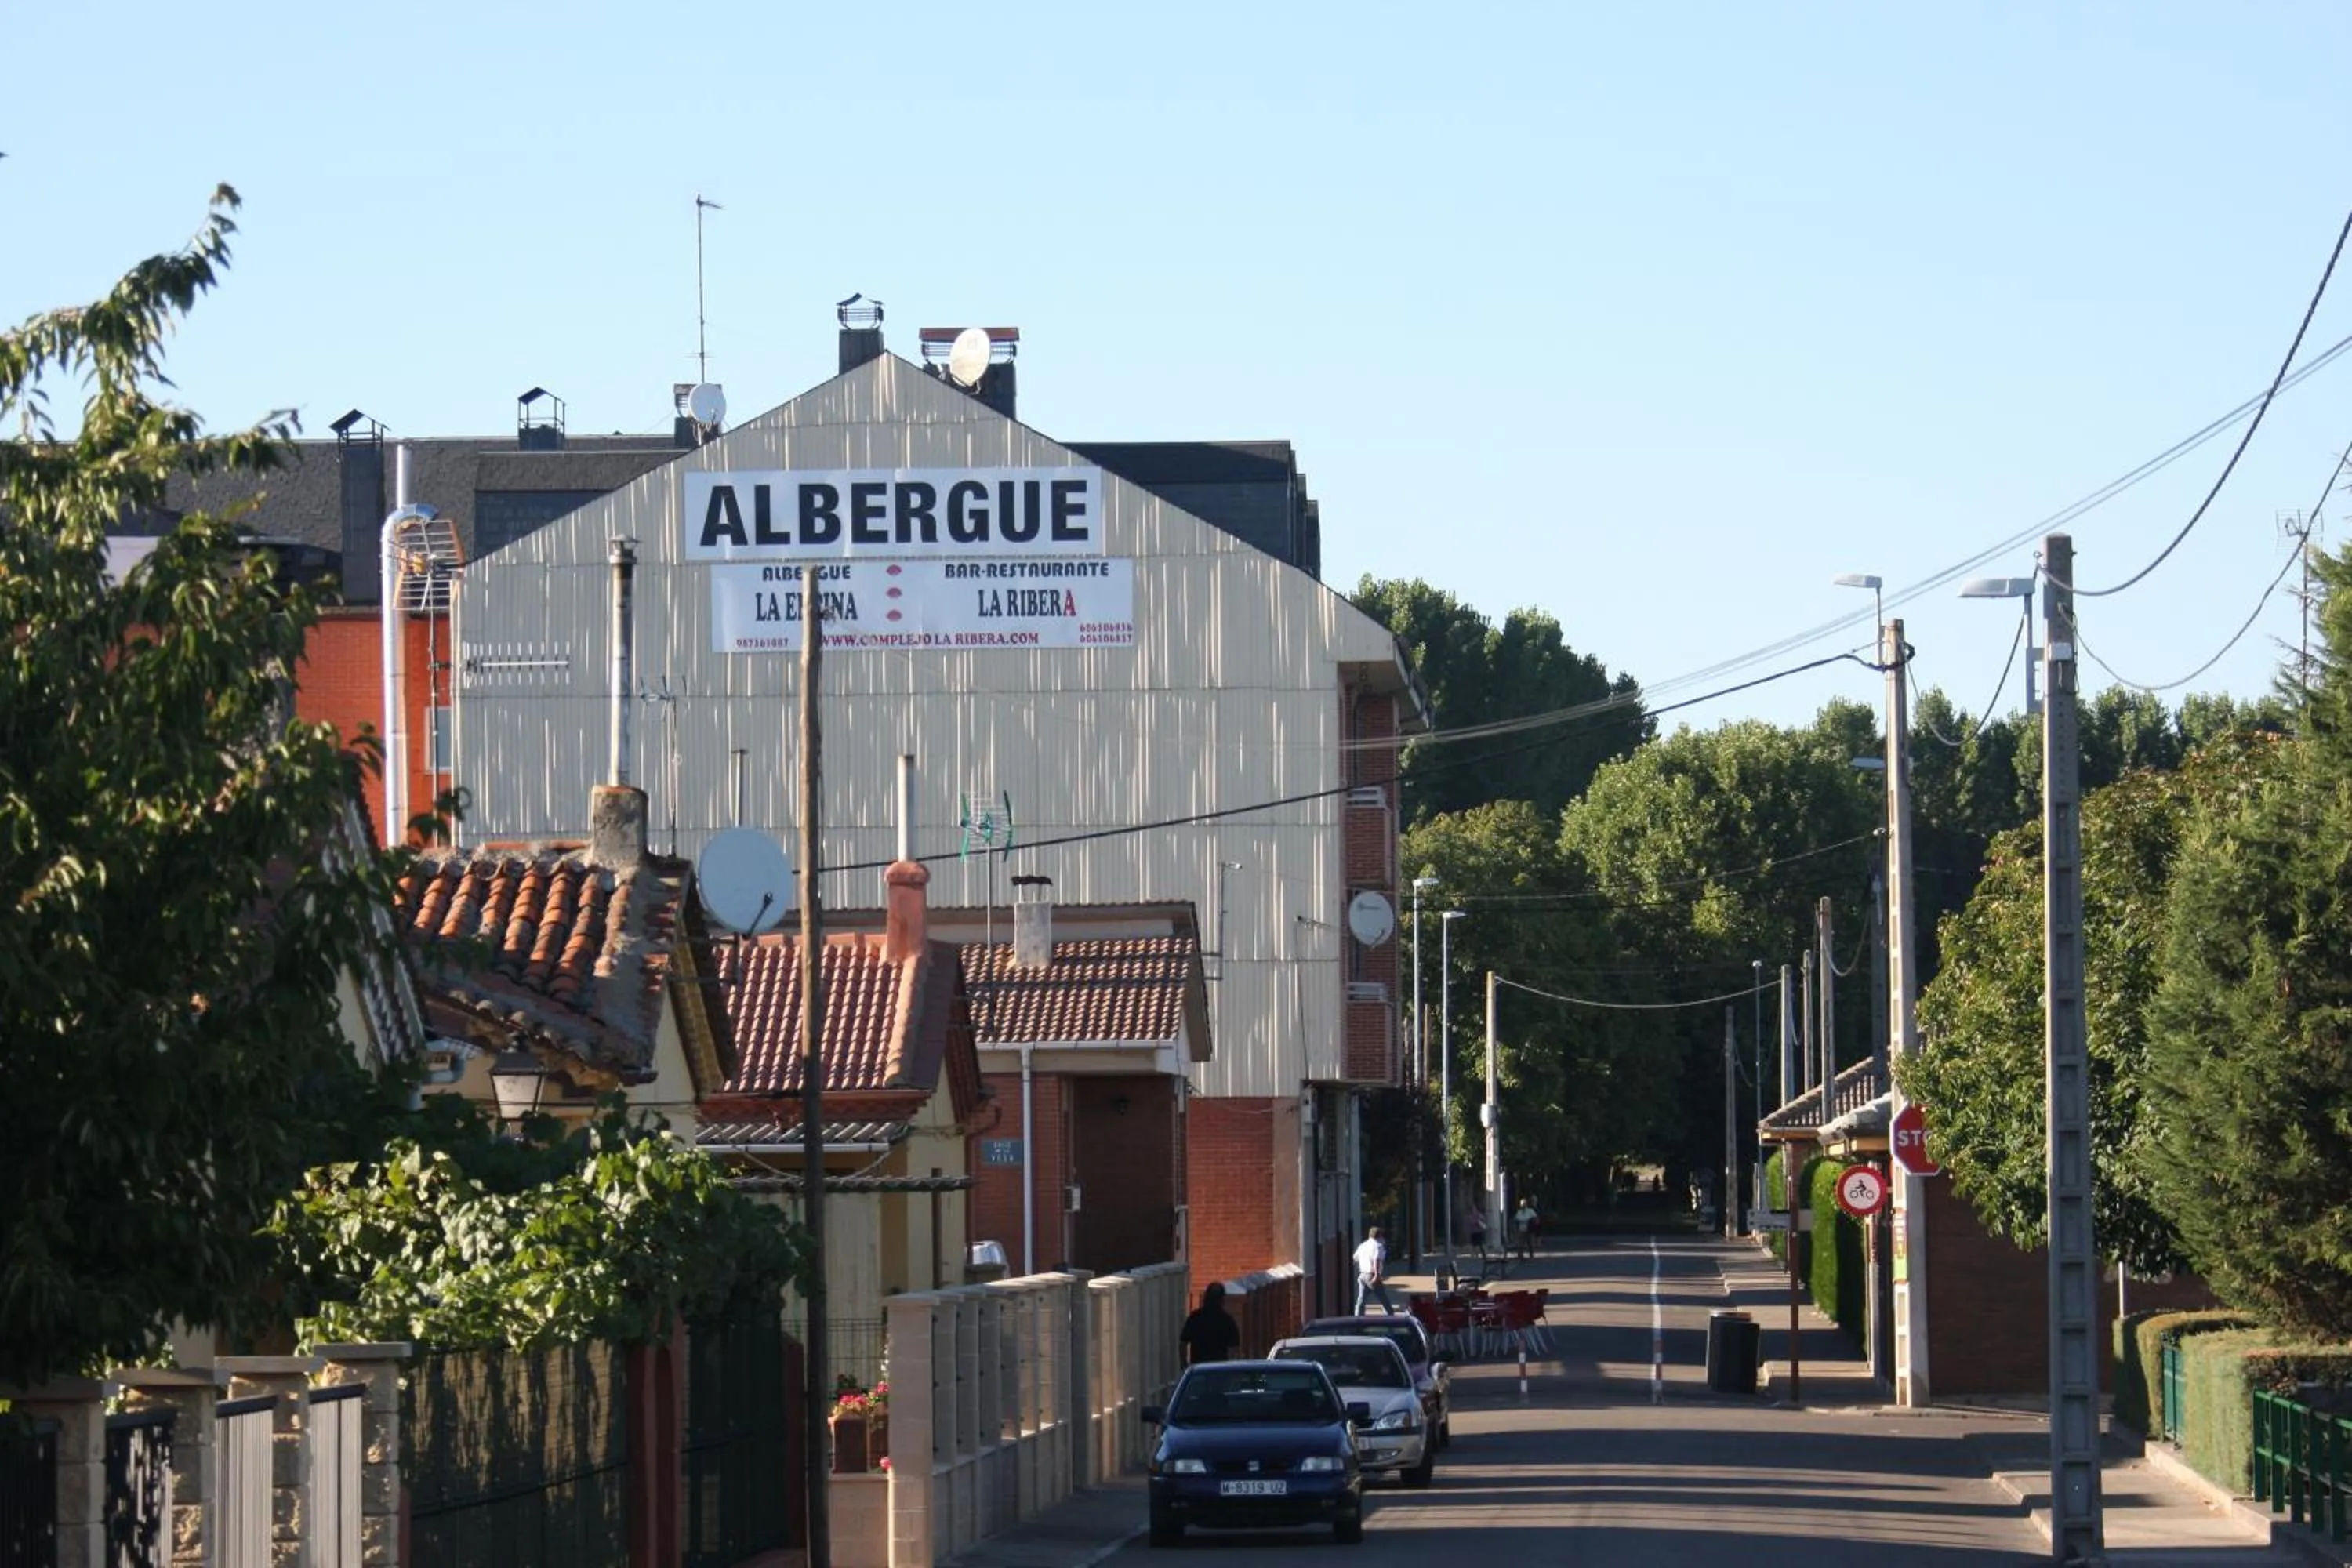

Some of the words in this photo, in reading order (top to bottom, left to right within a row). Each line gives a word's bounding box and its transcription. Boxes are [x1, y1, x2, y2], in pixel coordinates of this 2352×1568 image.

[699, 479, 1089, 546] ALBERGUE
[762, 564, 851, 582] ALBEGUE
[945, 562, 1109, 578] BAR-RESTAURANTE
[756, 592, 781, 621] LA
[978, 589, 1002, 617] LA
[1007, 588, 1076, 617] RIBERA
[955, 632, 1039, 645] RIBERA.COM
[1898, 1129, 1934, 1147] ST
